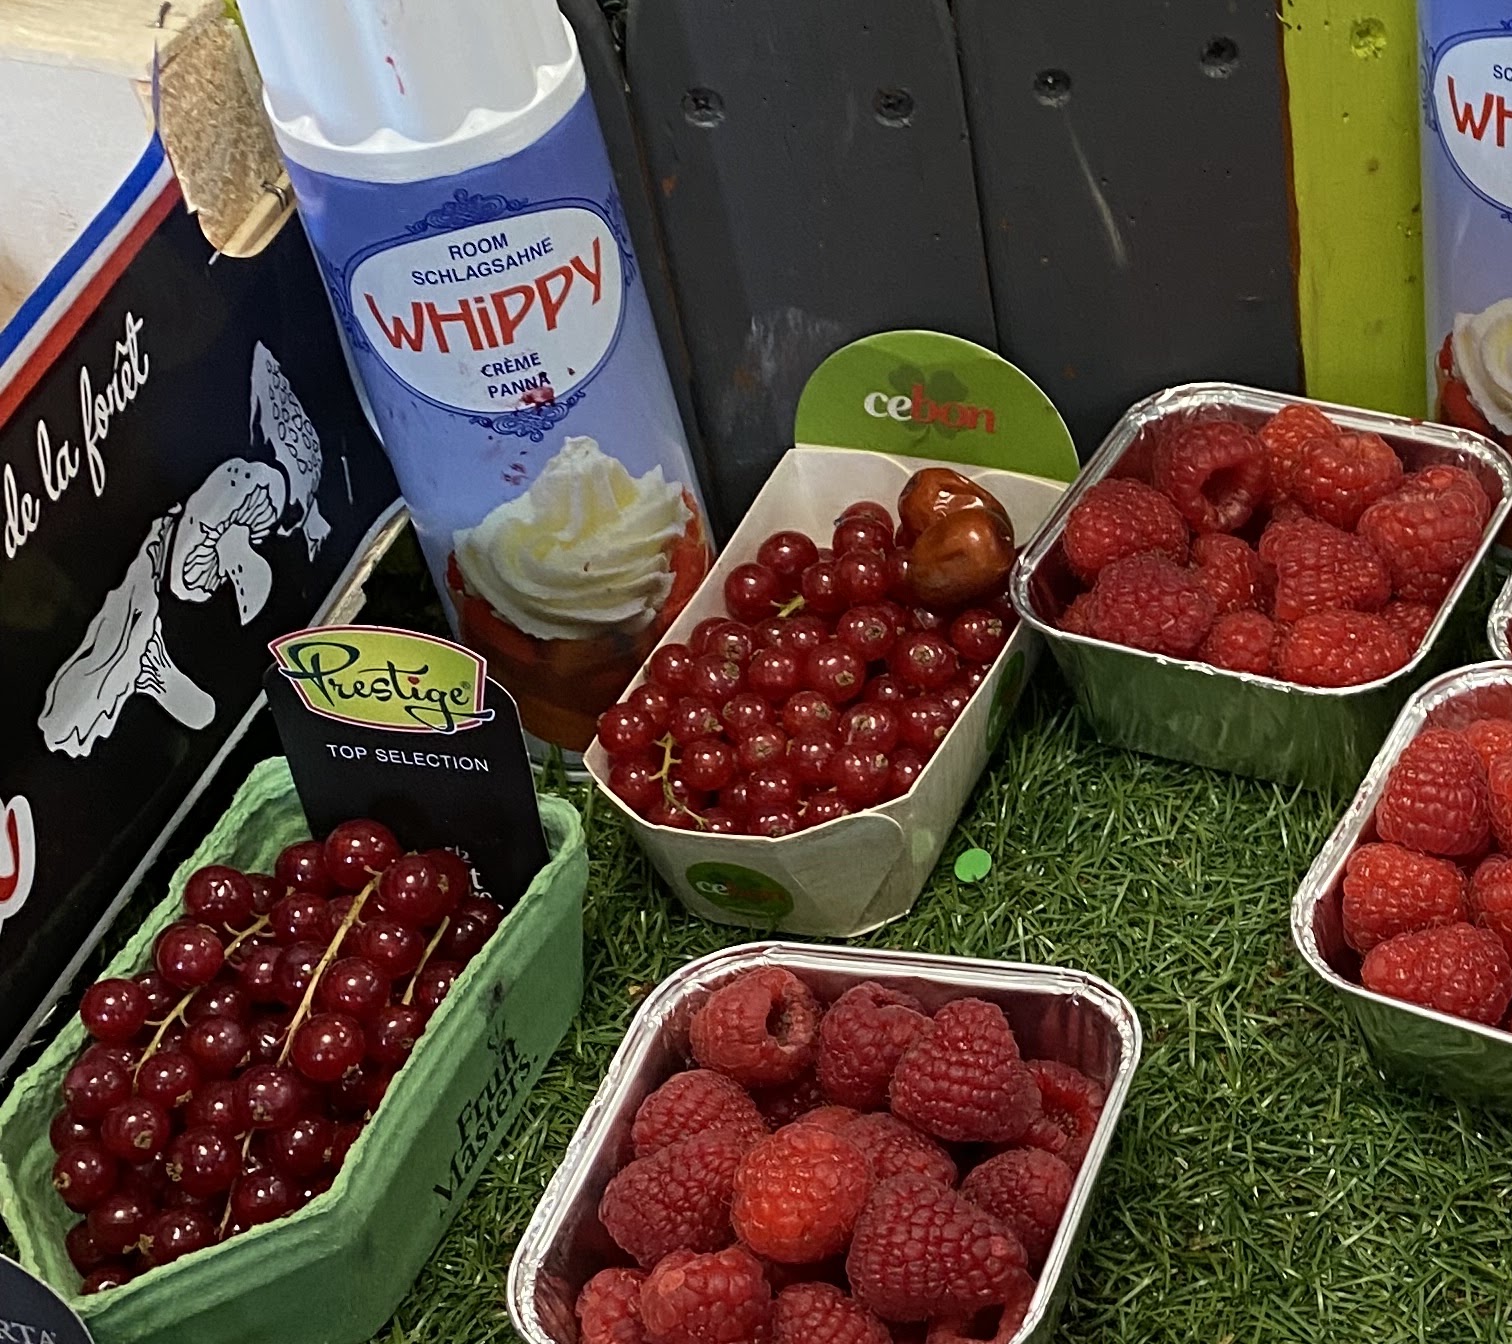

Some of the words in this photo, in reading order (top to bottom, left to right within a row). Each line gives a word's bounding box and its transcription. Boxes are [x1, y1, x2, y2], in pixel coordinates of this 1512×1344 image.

[410, 236, 555, 288] SCHLAGSAHNE
[446, 231, 510, 263] ROOM
[479, 351, 542, 380] CRÈME
[487, 372, 552, 401] PANNA
[3, 465, 40, 558] de
[35, 418, 79, 504] la
[78, 311, 150, 498] forêt
[863, 383, 997, 435] cebon
[278, 641, 497, 734] Prestige
[325, 743, 368, 760] TOP
[374, 747, 491, 773] SELECTION
[456, 1038, 522, 1146] Fruit
